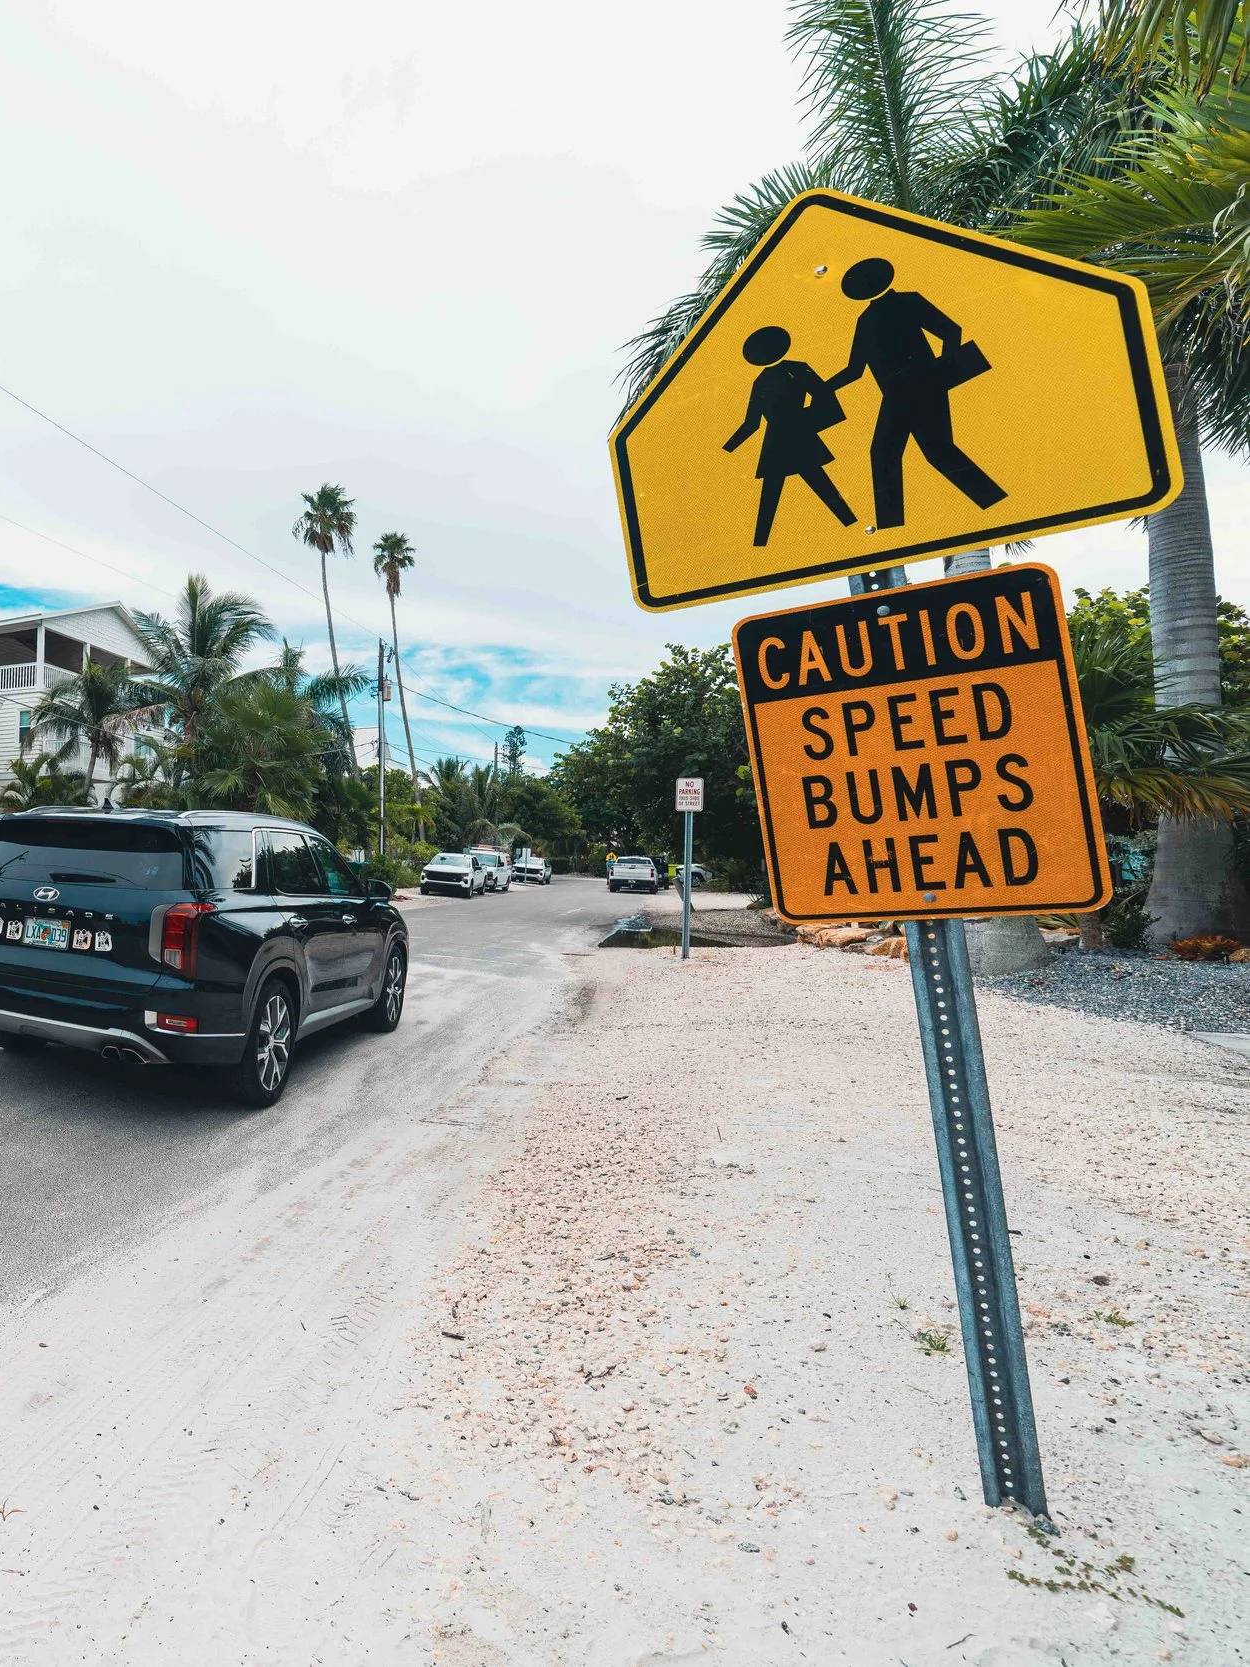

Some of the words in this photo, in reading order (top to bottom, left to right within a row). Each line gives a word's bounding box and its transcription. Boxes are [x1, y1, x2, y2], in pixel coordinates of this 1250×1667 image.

[758, 591, 1040, 690] CAUTION
[802, 682, 1012, 761] SPEED
[802, 753, 1034, 830] BUMPS
[824, 827, 1039, 897] AHEAD
[26, 924, 41, 939] LXA
